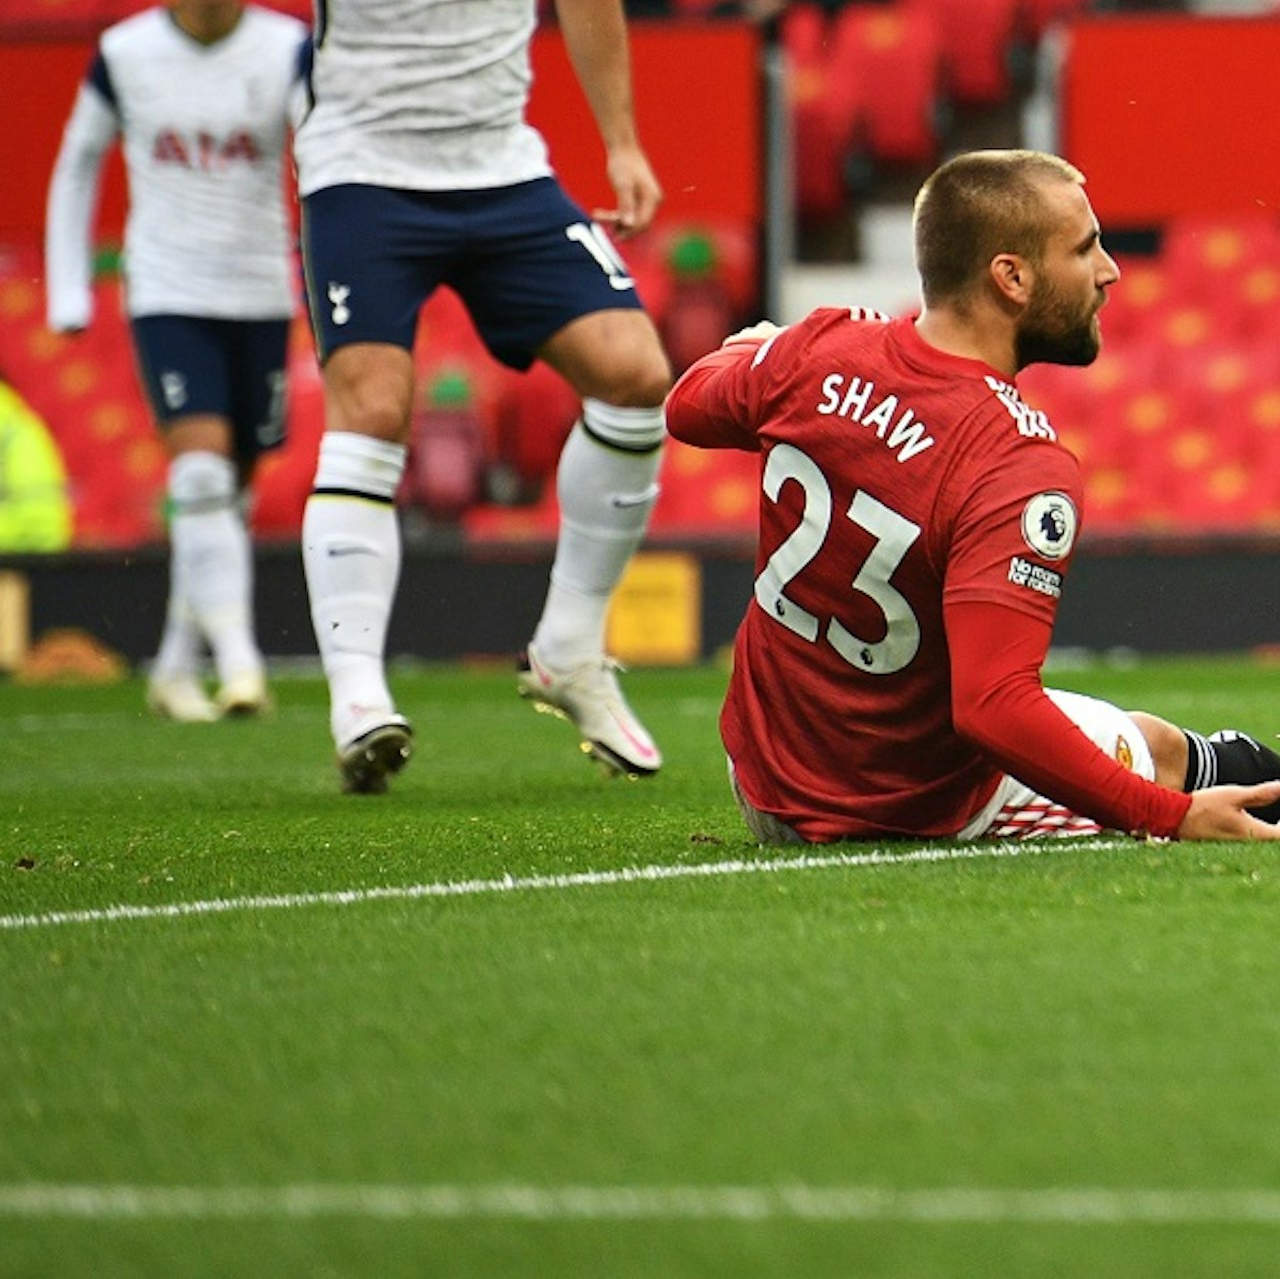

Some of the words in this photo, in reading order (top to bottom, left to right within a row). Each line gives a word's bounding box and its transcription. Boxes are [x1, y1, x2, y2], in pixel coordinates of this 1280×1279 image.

[152, 127, 263, 168] AIA
[817, 372, 934, 463] SHAW
[754, 443, 922, 676] 23
